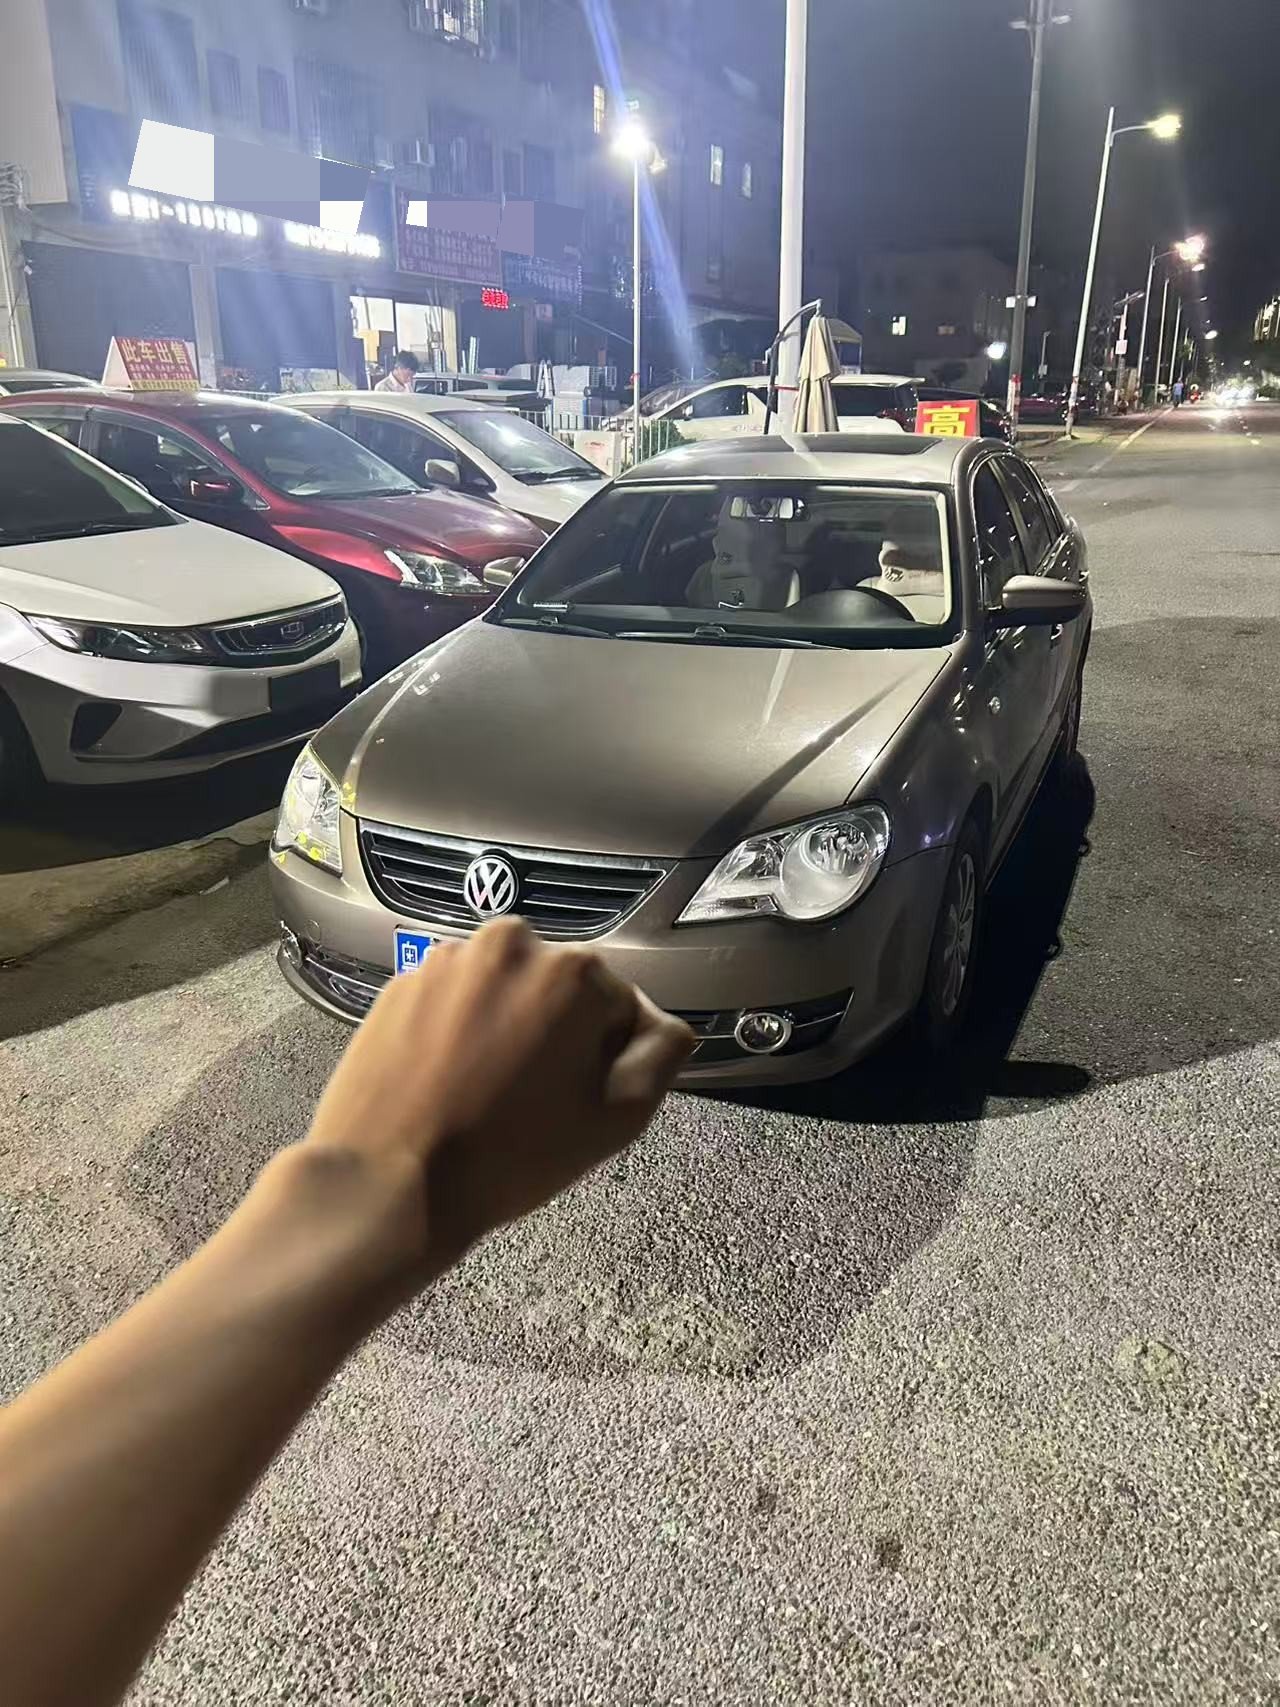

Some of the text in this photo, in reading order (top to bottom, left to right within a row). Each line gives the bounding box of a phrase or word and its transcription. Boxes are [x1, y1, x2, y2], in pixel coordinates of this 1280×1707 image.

[121, 339, 188, 365] 此车出售
[923, 405, 970, 438] 高
